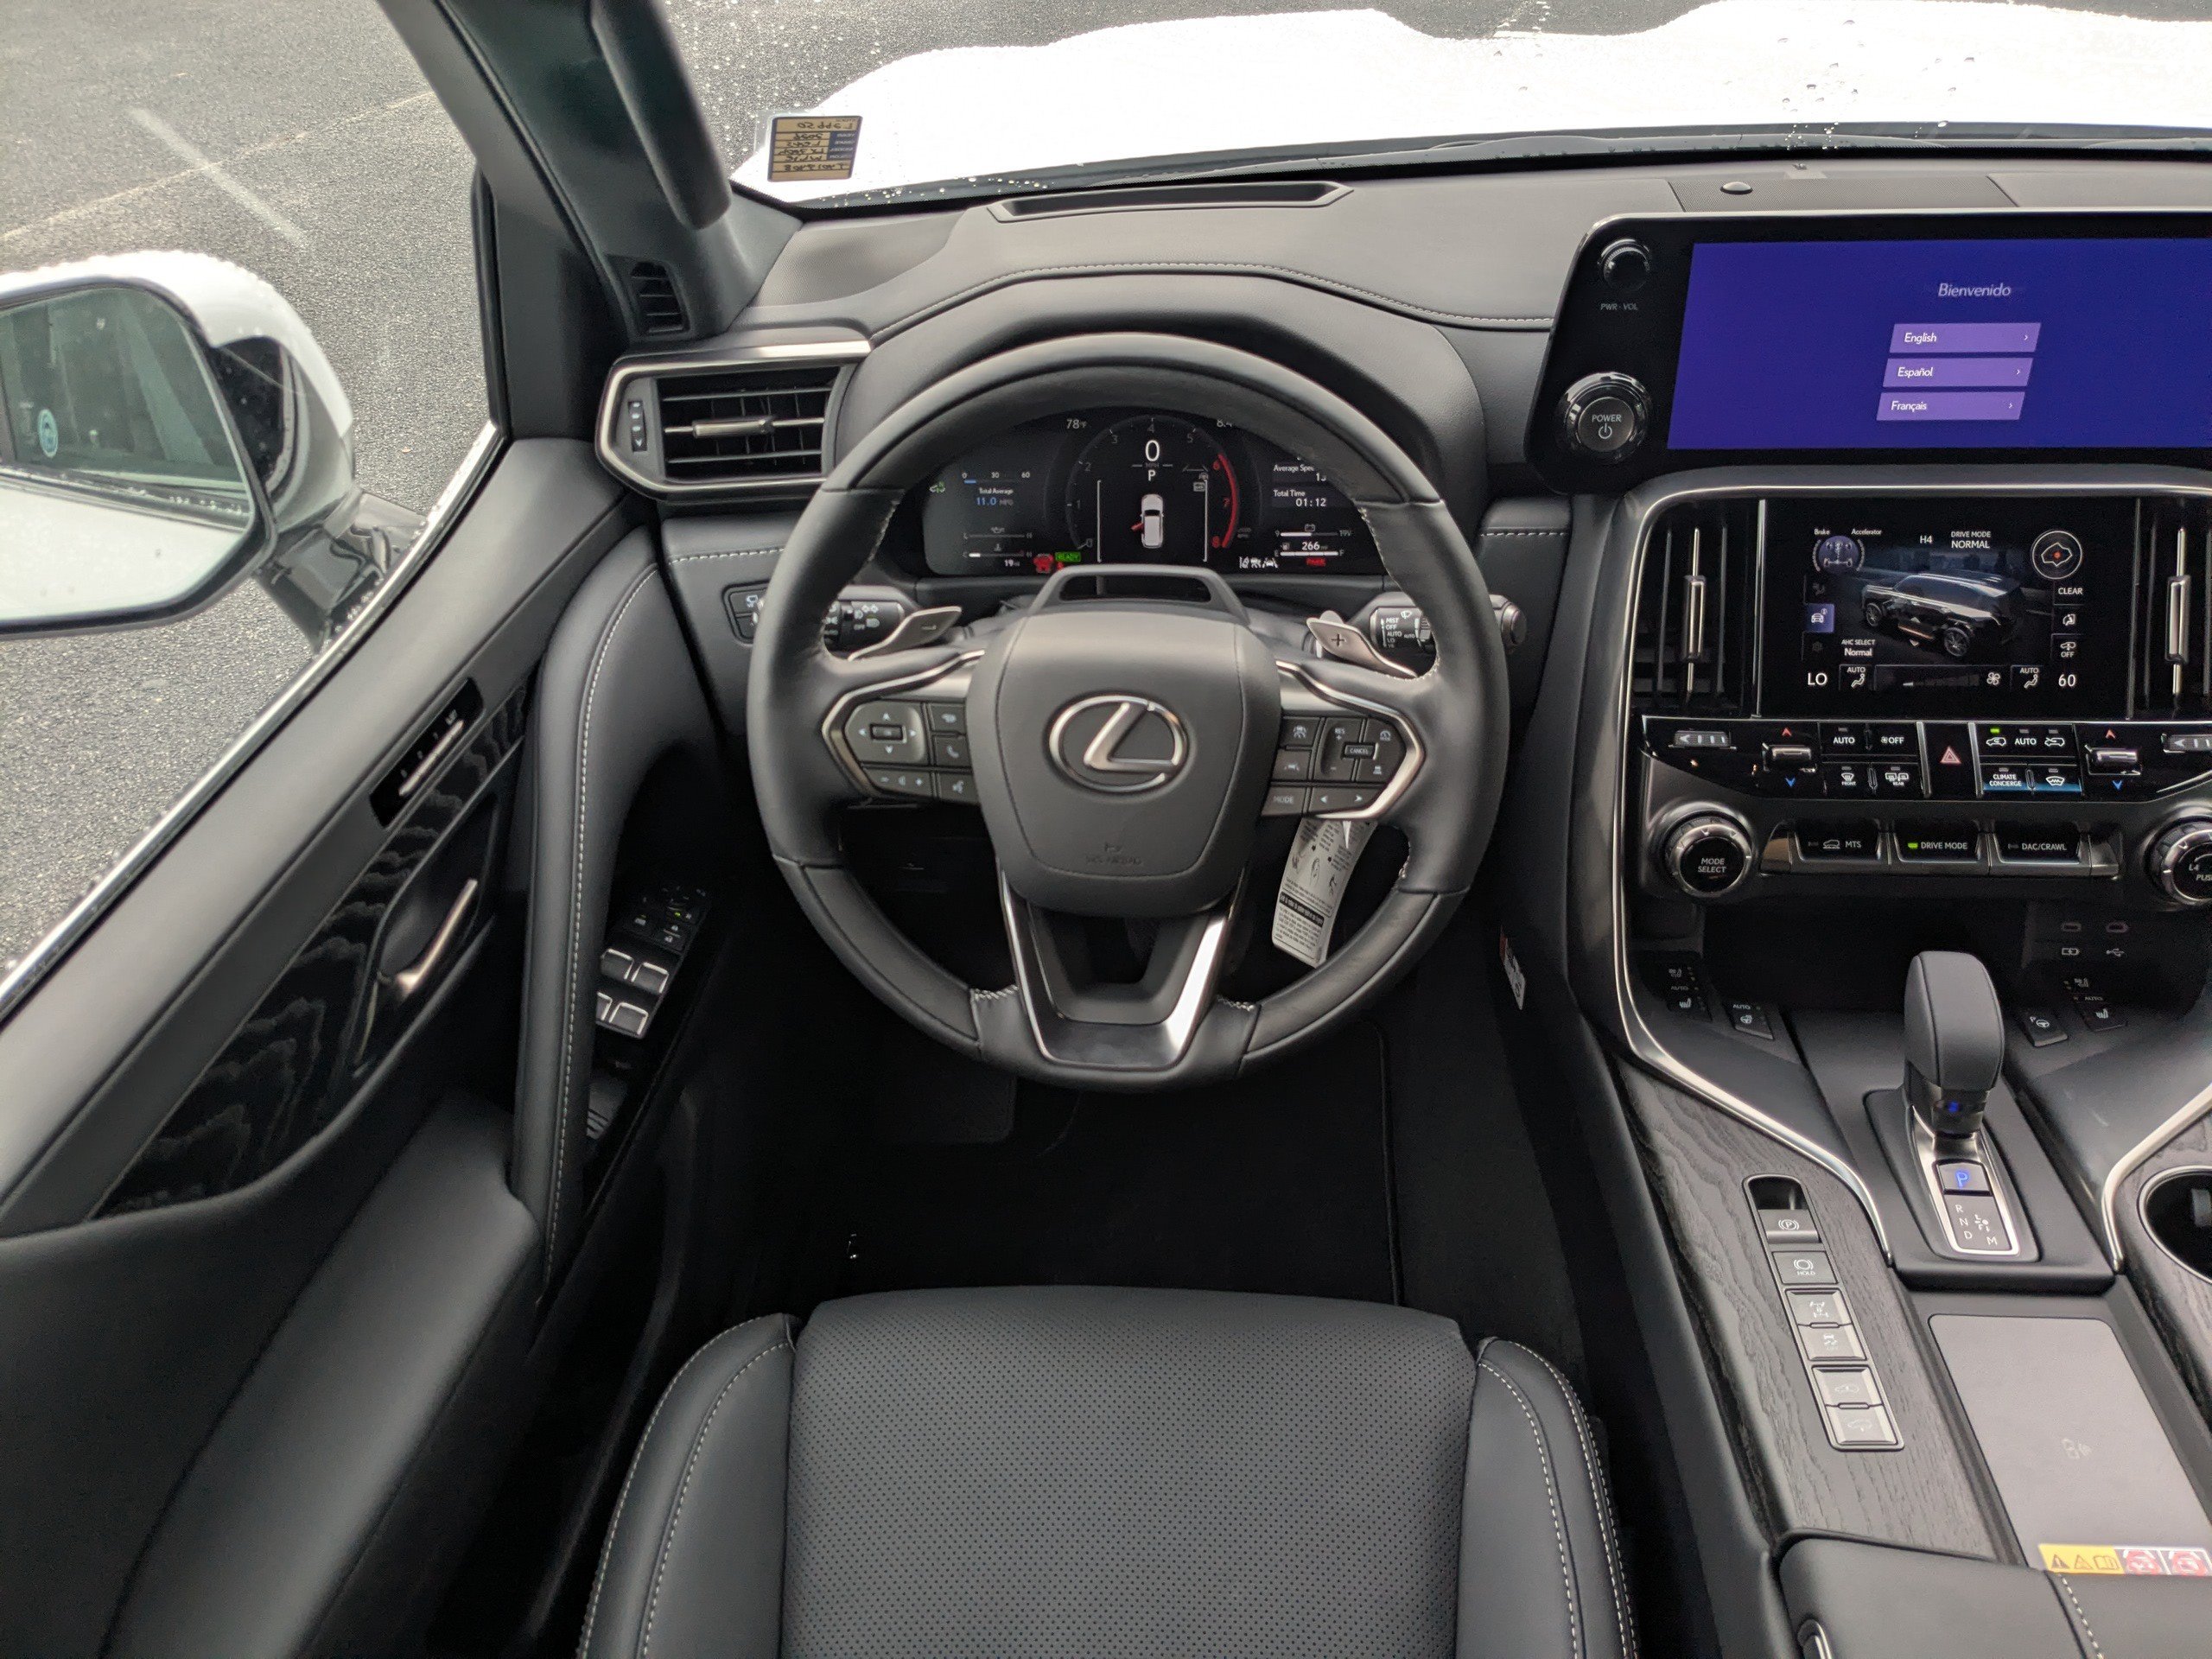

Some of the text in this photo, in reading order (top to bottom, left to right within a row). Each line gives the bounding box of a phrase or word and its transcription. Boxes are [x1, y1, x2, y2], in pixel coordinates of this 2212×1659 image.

[1937, 282, 2012, 298] Bienvenido
[1904, 332, 1937, 345] English
[1897, 366, 1934, 378] Español
[1891, 400, 1928, 413] Français
[1592, 414, 1622, 423] POWER
[1111, 434, 1119, 445] 3
[1186, 434, 1194, 444] 5
[1145, 439, 1161, 462] 0
[1084, 461, 1092, 473] 2
[1273, 464, 1298, 473] Average
[1147, 468, 1157, 481] P
[1273, 488, 1306, 498] Total Time
[976, 496, 997, 506] 11.0
[1295, 498, 1327, 507] 01:12
[1919, 535, 1934, 544] H4
[1301, 541, 1320, 550] 266
[1950, 540, 1991, 550] NORMAL
[2057, 587, 2083, 596] CLEAR
[1844, 648, 1873, 658] Normal
[2060, 650, 2075, 658] OFF
[1847, 665, 1866, 674] AUTO
[2019, 666, 2039, 675] AUTO
[1807, 672, 1827, 686] LO
[2057, 674, 2076, 688] 60
[1833, 736, 1856, 745] AUTO
[1888, 736, 1904, 745] OFF
[2014, 737, 2037, 746] AUTO
[1349, 747, 1370, 755] CANCEL
[1844, 841, 1862, 849] MTS
[1920, 841, 1968, 850] DRIVE MODE
[2021, 842, 2068, 851] DAC/CRAWL
[1697, 865, 1727, 874] SELECT
[2188, 863, 2200, 872] L4
[1955, 1170, 1969, 1190] P
[1955, 1204, 1964, 1213] R
[1959, 1217, 1969, 1226] N
[1963, 1230, 1973, 1240] D
[1986, 1236, 1998, 1245] M
